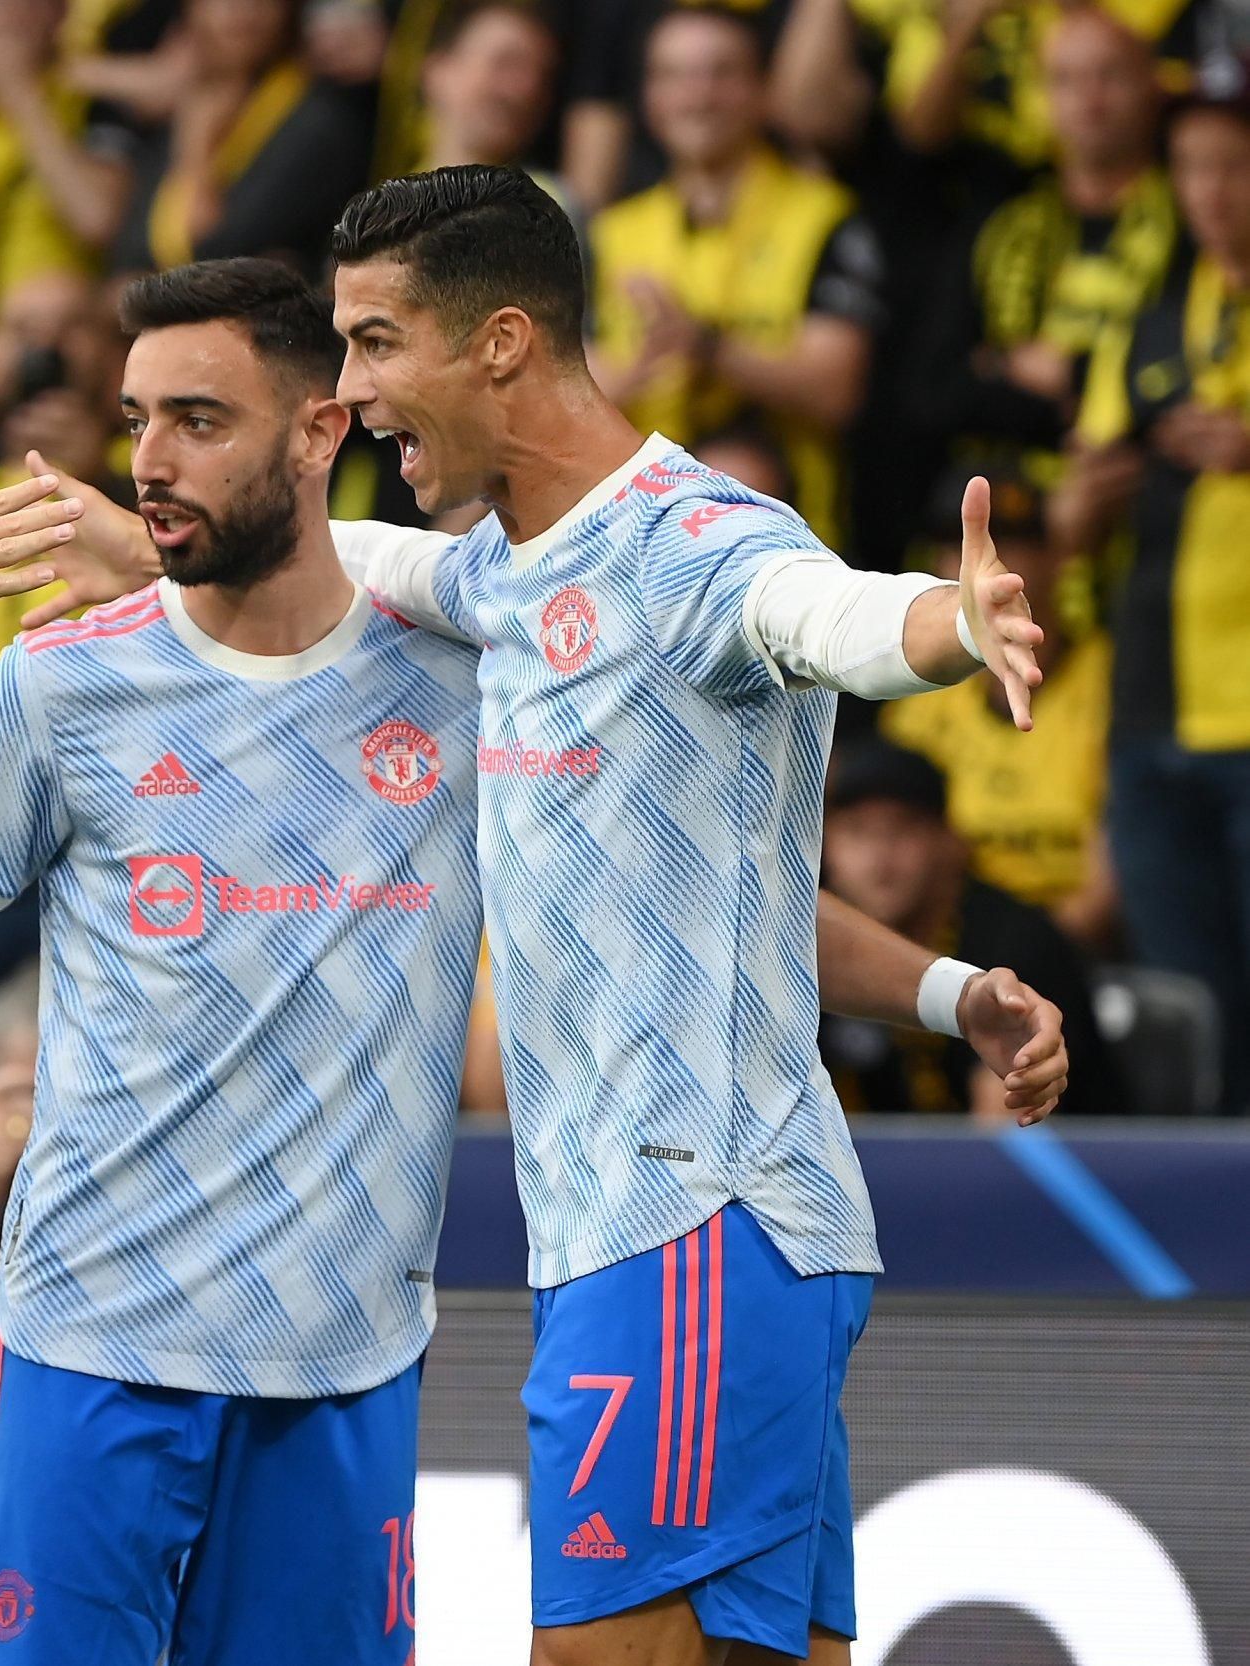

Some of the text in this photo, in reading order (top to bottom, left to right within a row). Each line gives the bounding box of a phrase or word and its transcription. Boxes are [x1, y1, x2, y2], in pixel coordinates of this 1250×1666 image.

[553, 653, 584, 670] UNITED
[365, 725, 433, 754] MANCHESTER
[133, 780, 201, 798] adidas
[381, 784, 428, 800] UNITED
[209, 873, 437, 913] TeamViewer
[568, 1374, 634, 1499] 7
[561, 1540, 628, 1559] adidas
